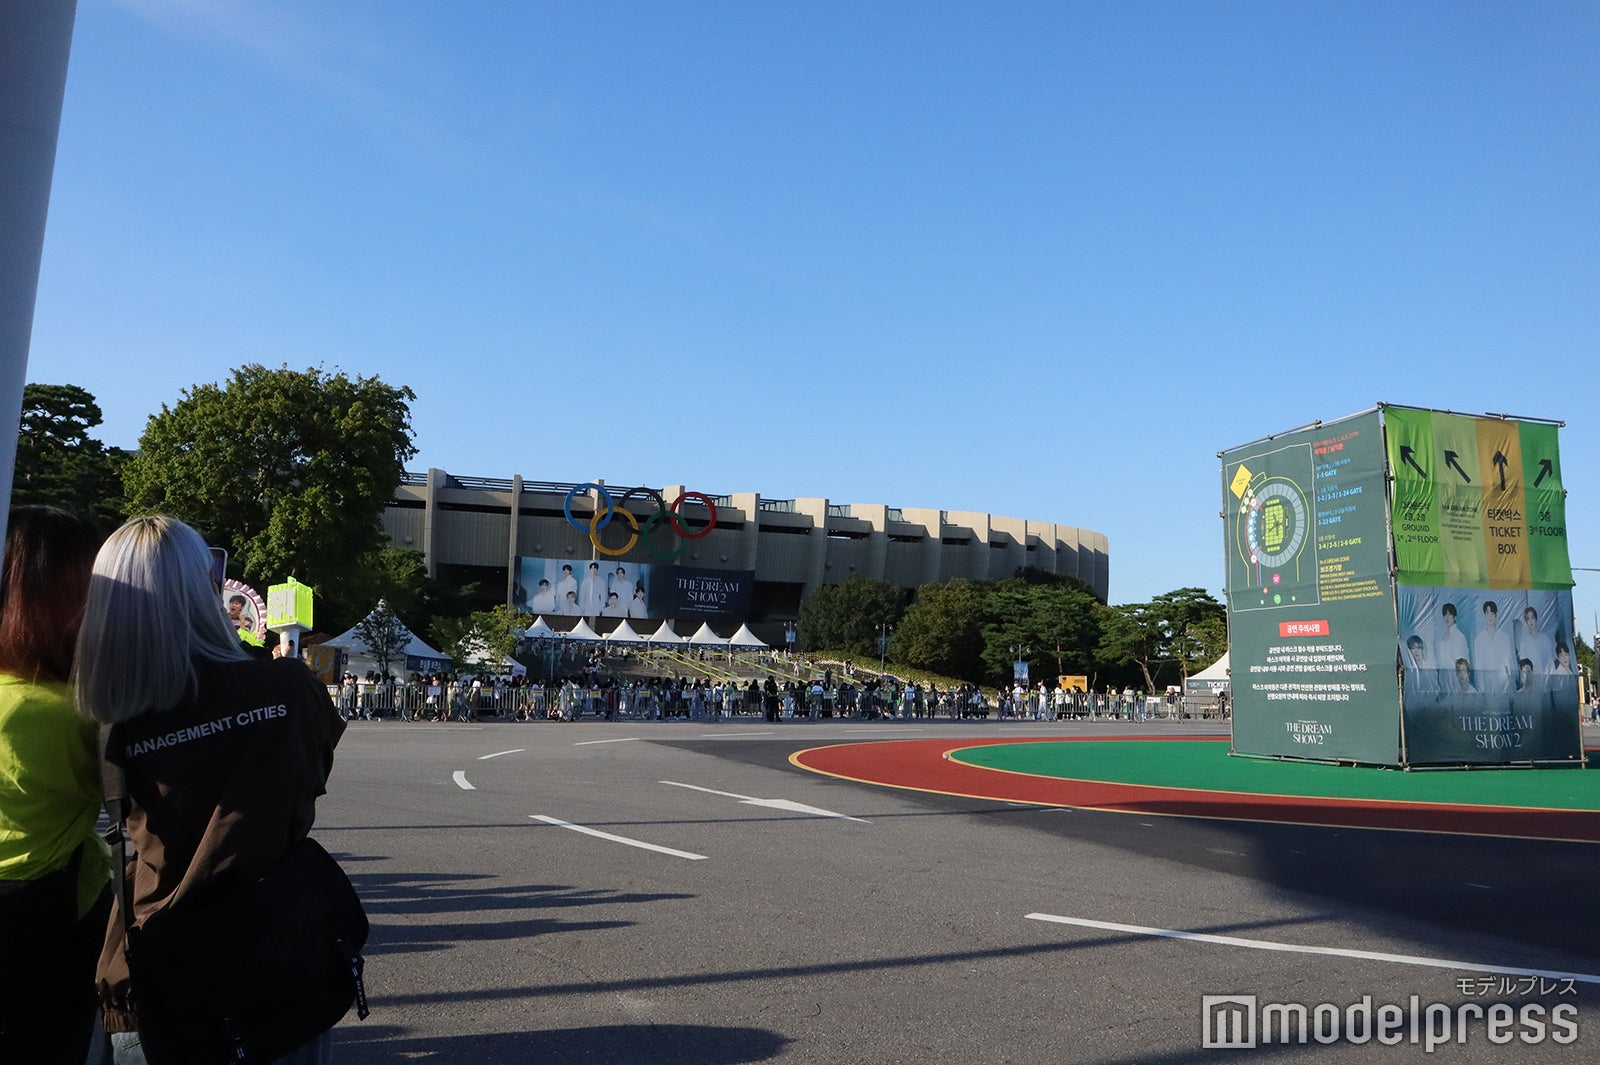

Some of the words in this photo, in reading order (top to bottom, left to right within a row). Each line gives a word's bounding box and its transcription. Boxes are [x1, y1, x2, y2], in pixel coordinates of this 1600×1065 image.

[1324, 469, 1338, 477] GATE
[1349, 486, 1362, 495] GATE
[1329, 515, 1342, 524] GATE
[1487, 508, 1522, 521] 티켓박스
[1402, 524, 1430, 532] GROUND
[1489, 526, 1521, 538] TICKET
[1539, 526, 1566, 537] FLOOR
[1348, 537, 1362, 545] GATE
[1417, 535, 1439, 544] FLOOR
[1498, 543, 1517, 555] BOX
[677, 578, 700, 590] THE
[700, 580, 739, 592] DREAM
[688, 591, 719, 603] SHOW
[720, 593, 727, 604] 2
[1287, 624, 1298, 634] 공연
[1298, 623, 1320, 633] 주의사항
[1206, 681, 1229, 689] TICKET
[236, 704, 288, 726] CITIES
[1285, 722, 1301, 733] THE
[1301, 723, 1332, 734] DREAM
[1459, 716, 1487, 731] THE
[1489, 715, 1533, 731] DREAM
[1293, 733, 1317, 744] SHOW
[1317, 735, 1324, 745] 2
[1475, 733, 1513, 749] SHOW
[1514, 733, 1521, 747] 2
